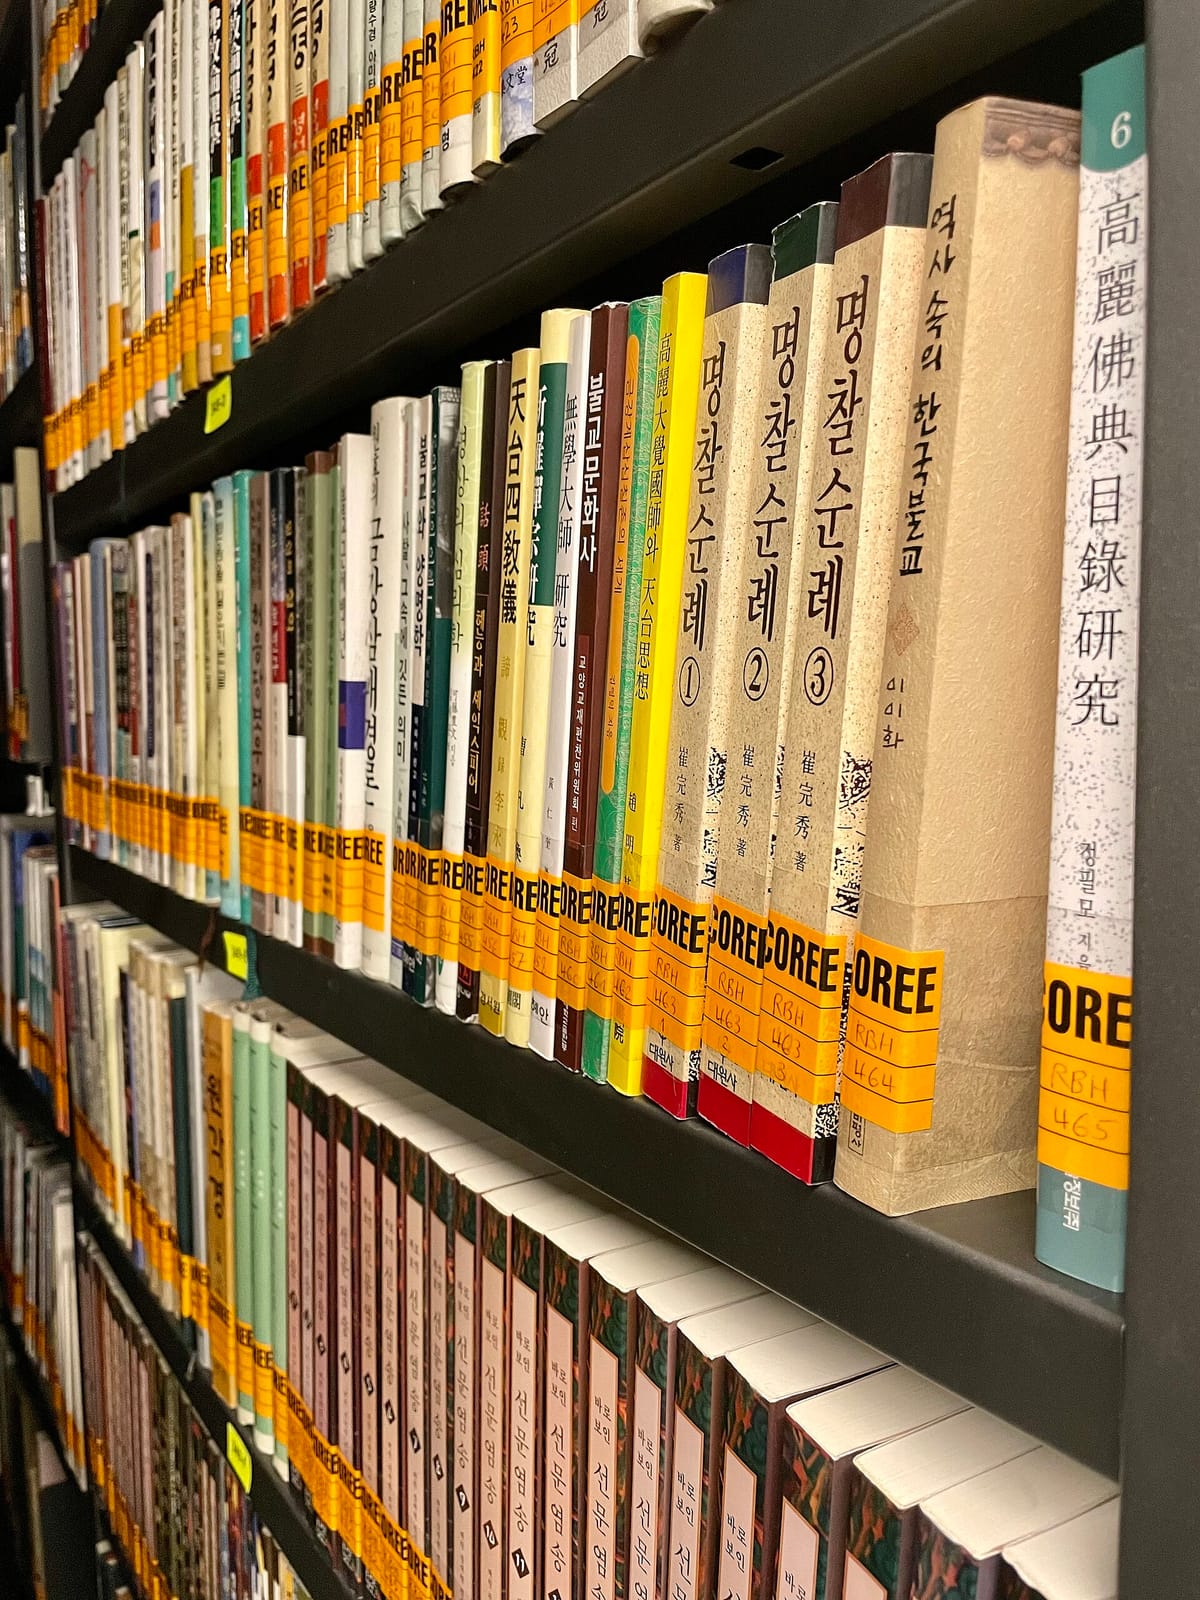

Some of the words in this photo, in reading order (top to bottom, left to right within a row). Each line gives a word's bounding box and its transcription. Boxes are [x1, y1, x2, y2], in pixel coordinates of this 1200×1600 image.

[1111, 111, 1132, 149] 6
[928, 194, 956, 279] 역사
[921, 289, 948, 371] 속의
[557, 392, 579, 554] 無學大師
[748, 306, 800, 642] 명찰순례
[808, 275, 869, 640] 명찰순례
[683, 341, 726, 651] 명찰순례
[635, 577, 657, 701] 天台思想
[882, 677, 904, 749] 이이화
[1074, 841, 1097, 919] 정필모
[717, 970, 745, 1001] RBH
[715, 1005, 741, 1035] 463
[772, 992, 804, 1028] RBH
[854, 1019, 896, 1052] RBH
[649, 1043, 674, 1071] 대원사
[707, 1057, 738, 1092] 대원사
[854, 1058, 896, 1093] 464
[1050, 1062, 1108, 1103] RBH
[1054, 1106, 1117, 1141] 465
